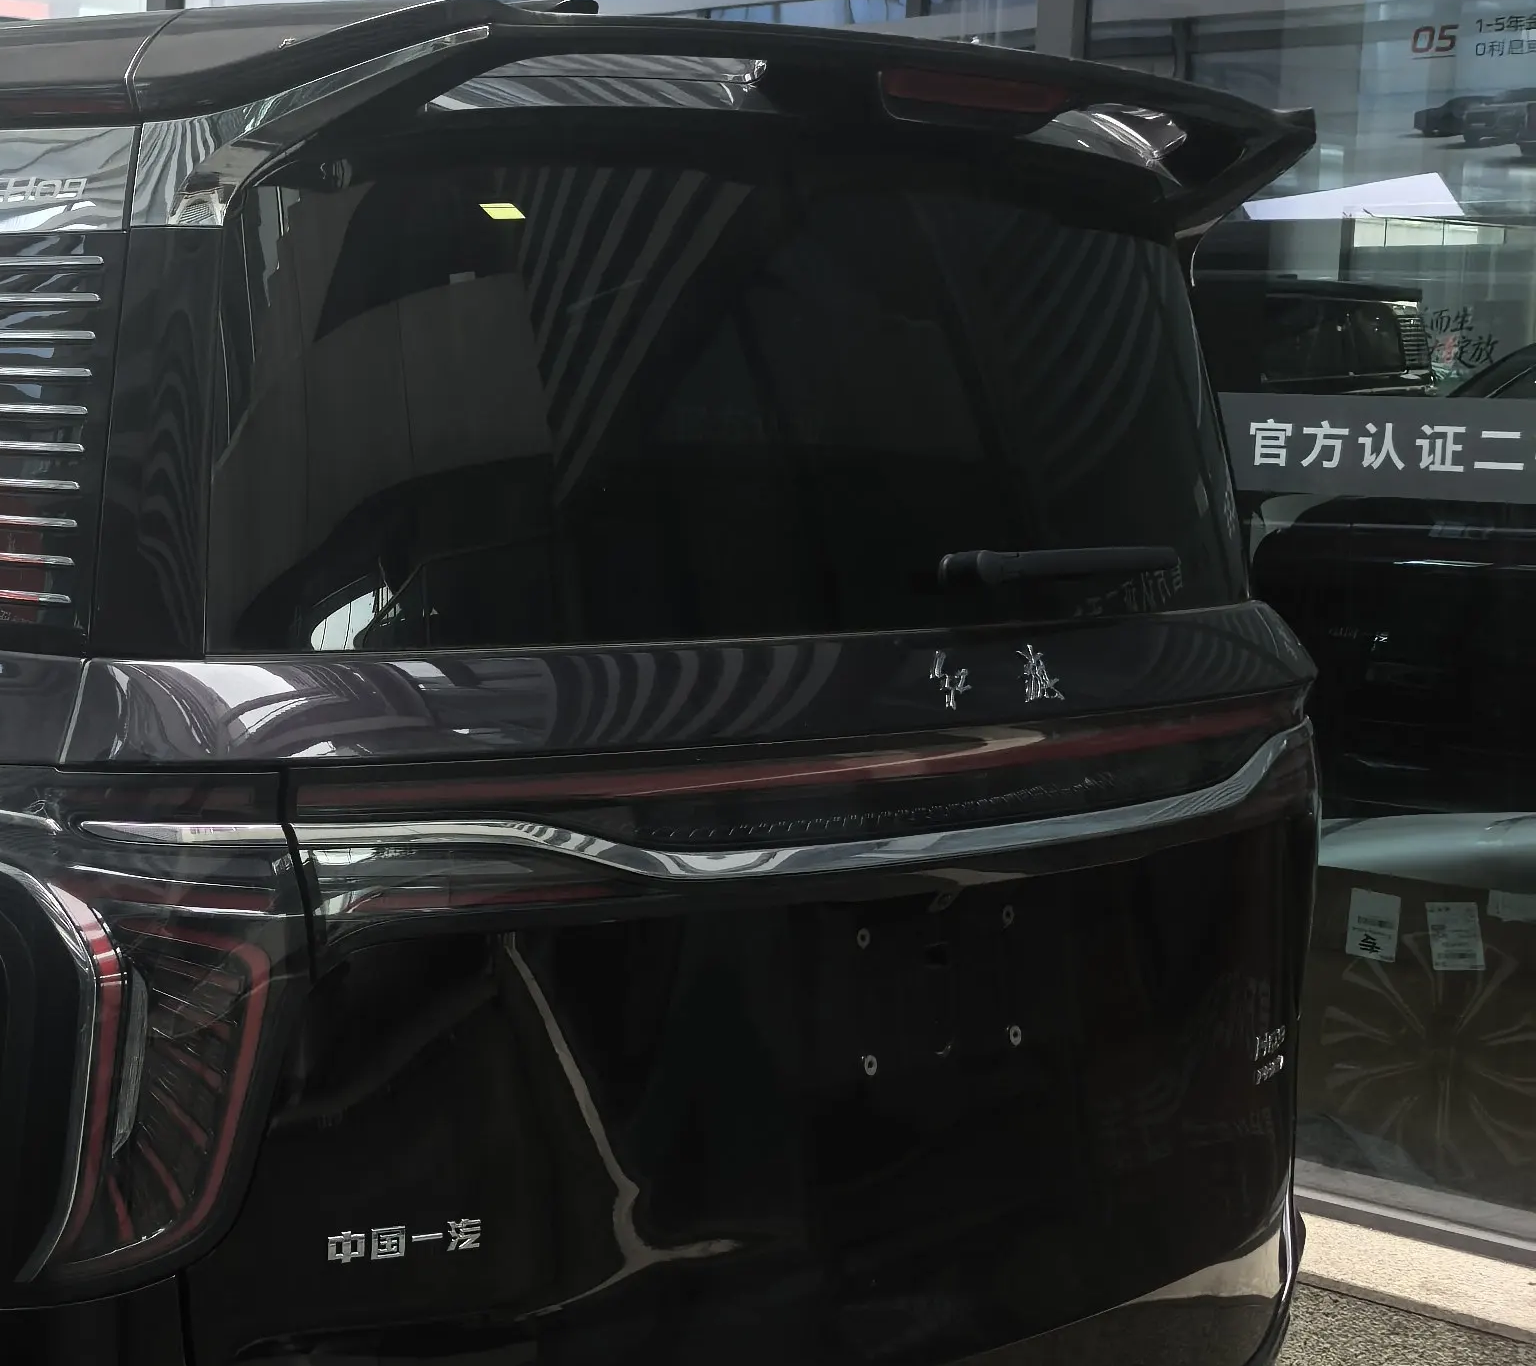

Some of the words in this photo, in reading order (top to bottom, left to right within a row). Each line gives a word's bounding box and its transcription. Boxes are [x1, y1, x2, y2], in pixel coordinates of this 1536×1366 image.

[1411, 24, 1460, 54] 05
[1250, 418, 1536, 473] 官方认证二
[327, 1218, 481, 1264] 中国一汽
